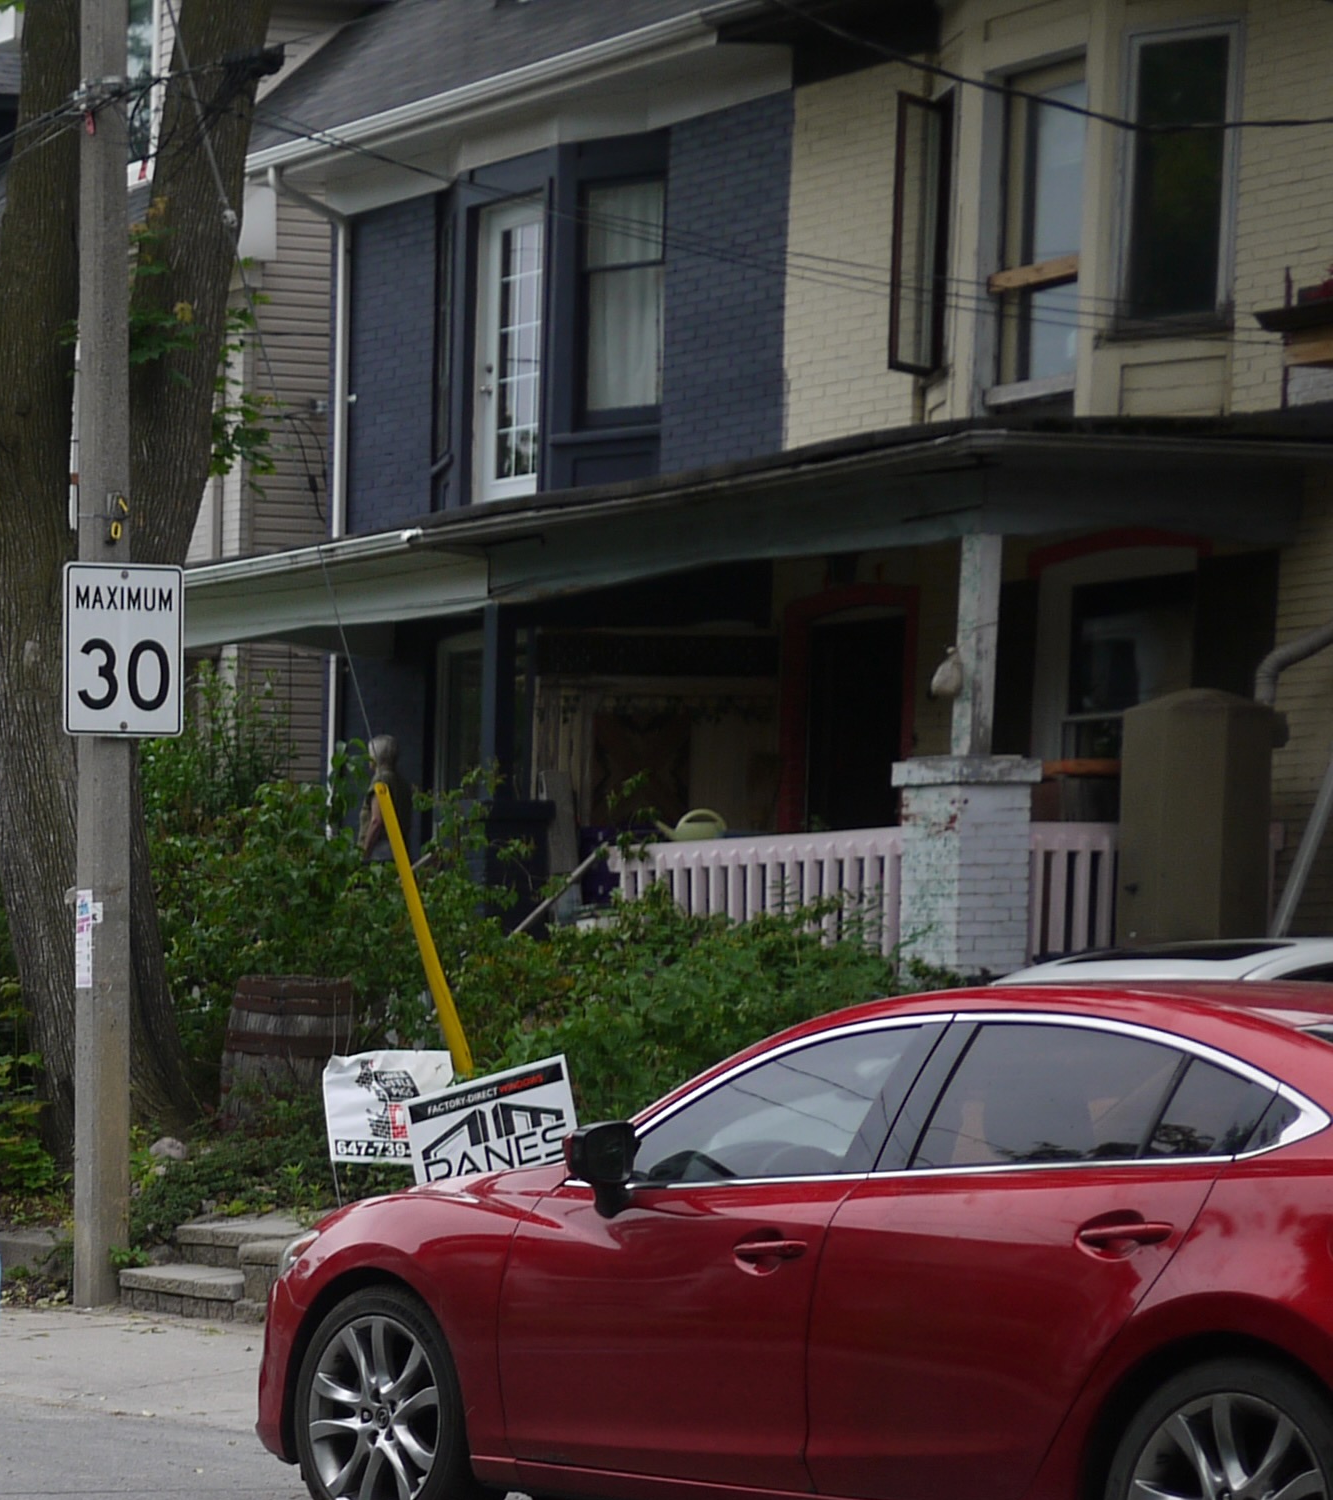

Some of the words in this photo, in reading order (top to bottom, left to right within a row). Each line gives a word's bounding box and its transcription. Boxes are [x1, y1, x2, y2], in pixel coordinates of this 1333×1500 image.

[76, 585, 173, 612] MAXIMUM
[77, 638, 171, 711] 30
[424, 1123, 567, 1182] PANES
